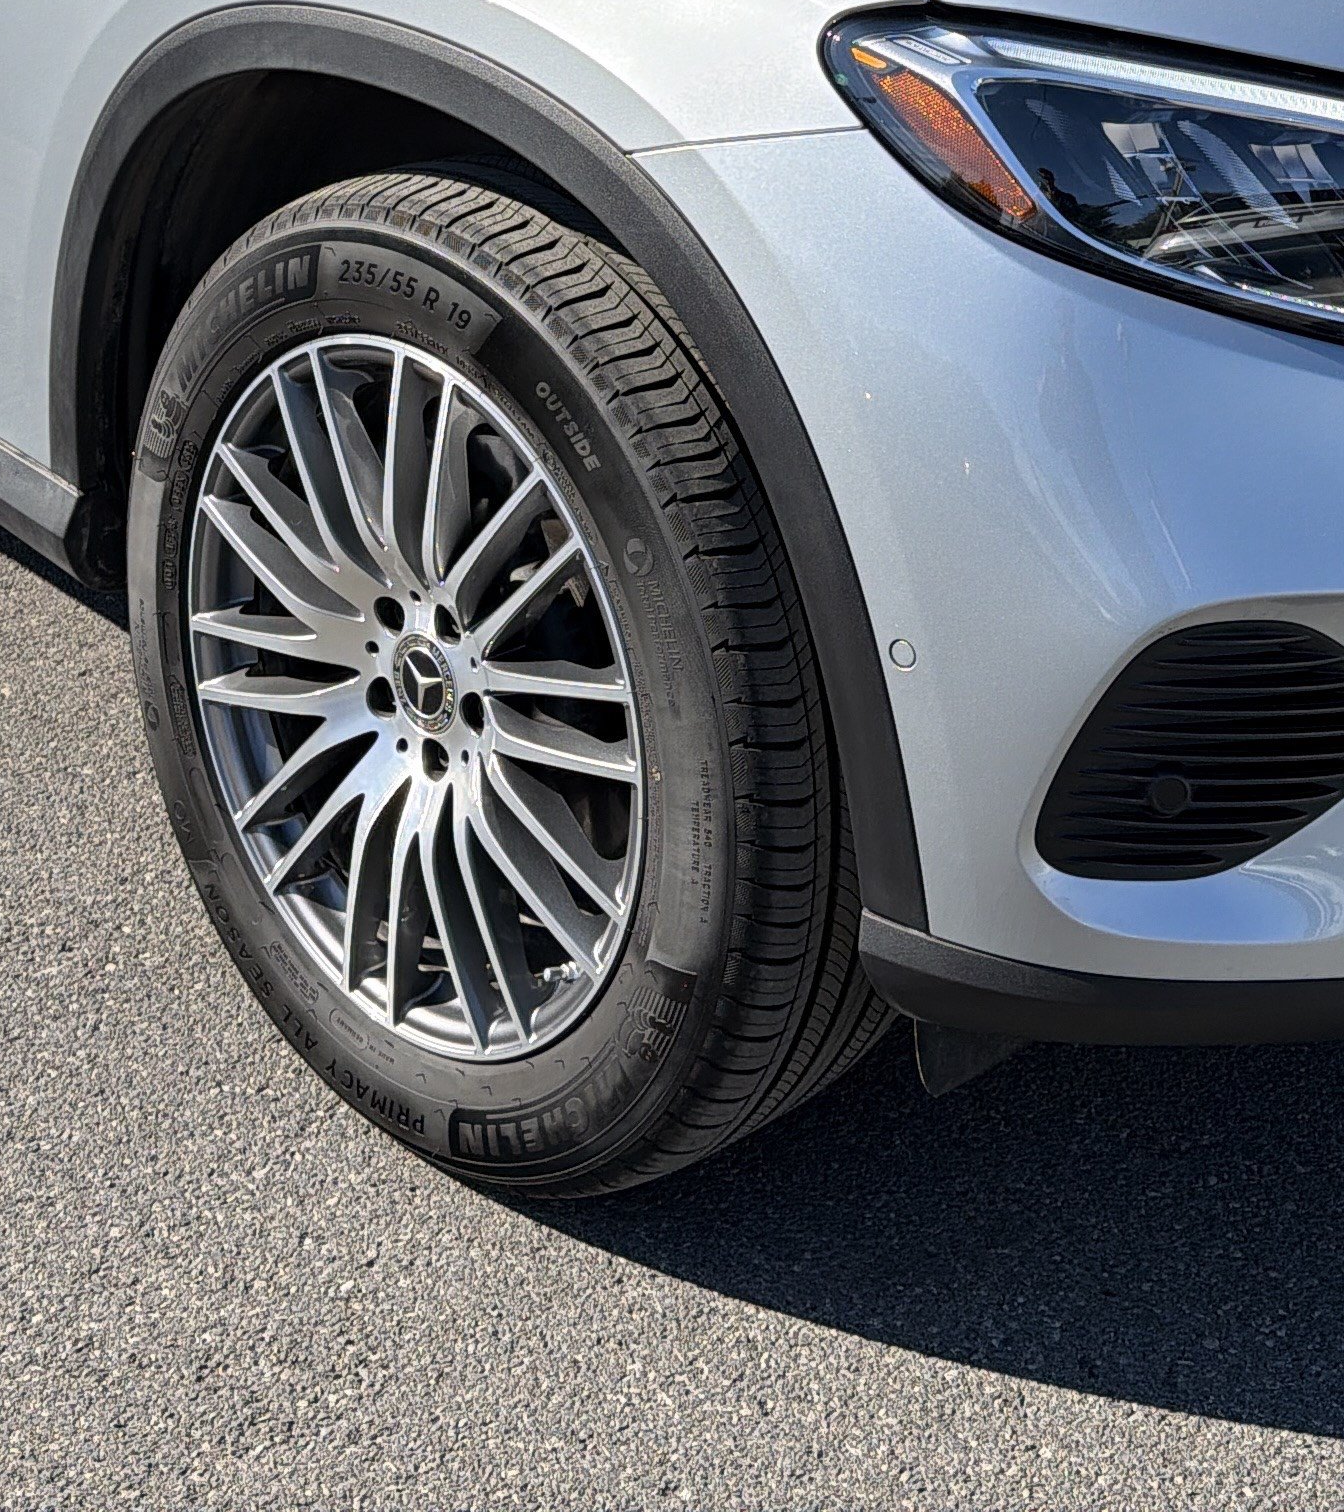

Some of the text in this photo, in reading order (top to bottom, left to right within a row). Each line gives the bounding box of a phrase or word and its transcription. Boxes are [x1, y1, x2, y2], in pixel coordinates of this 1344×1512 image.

[177, 252, 314, 393] MICHELIN
[338, 259, 472, 331] 235/55 R 19
[535, 380, 601, 473] OUTSIDE
[206, 884, 274, 999] SEASON
[283, 1004, 318, 1053] ALL
[325, 1058, 425, 1136] PRIMACY
